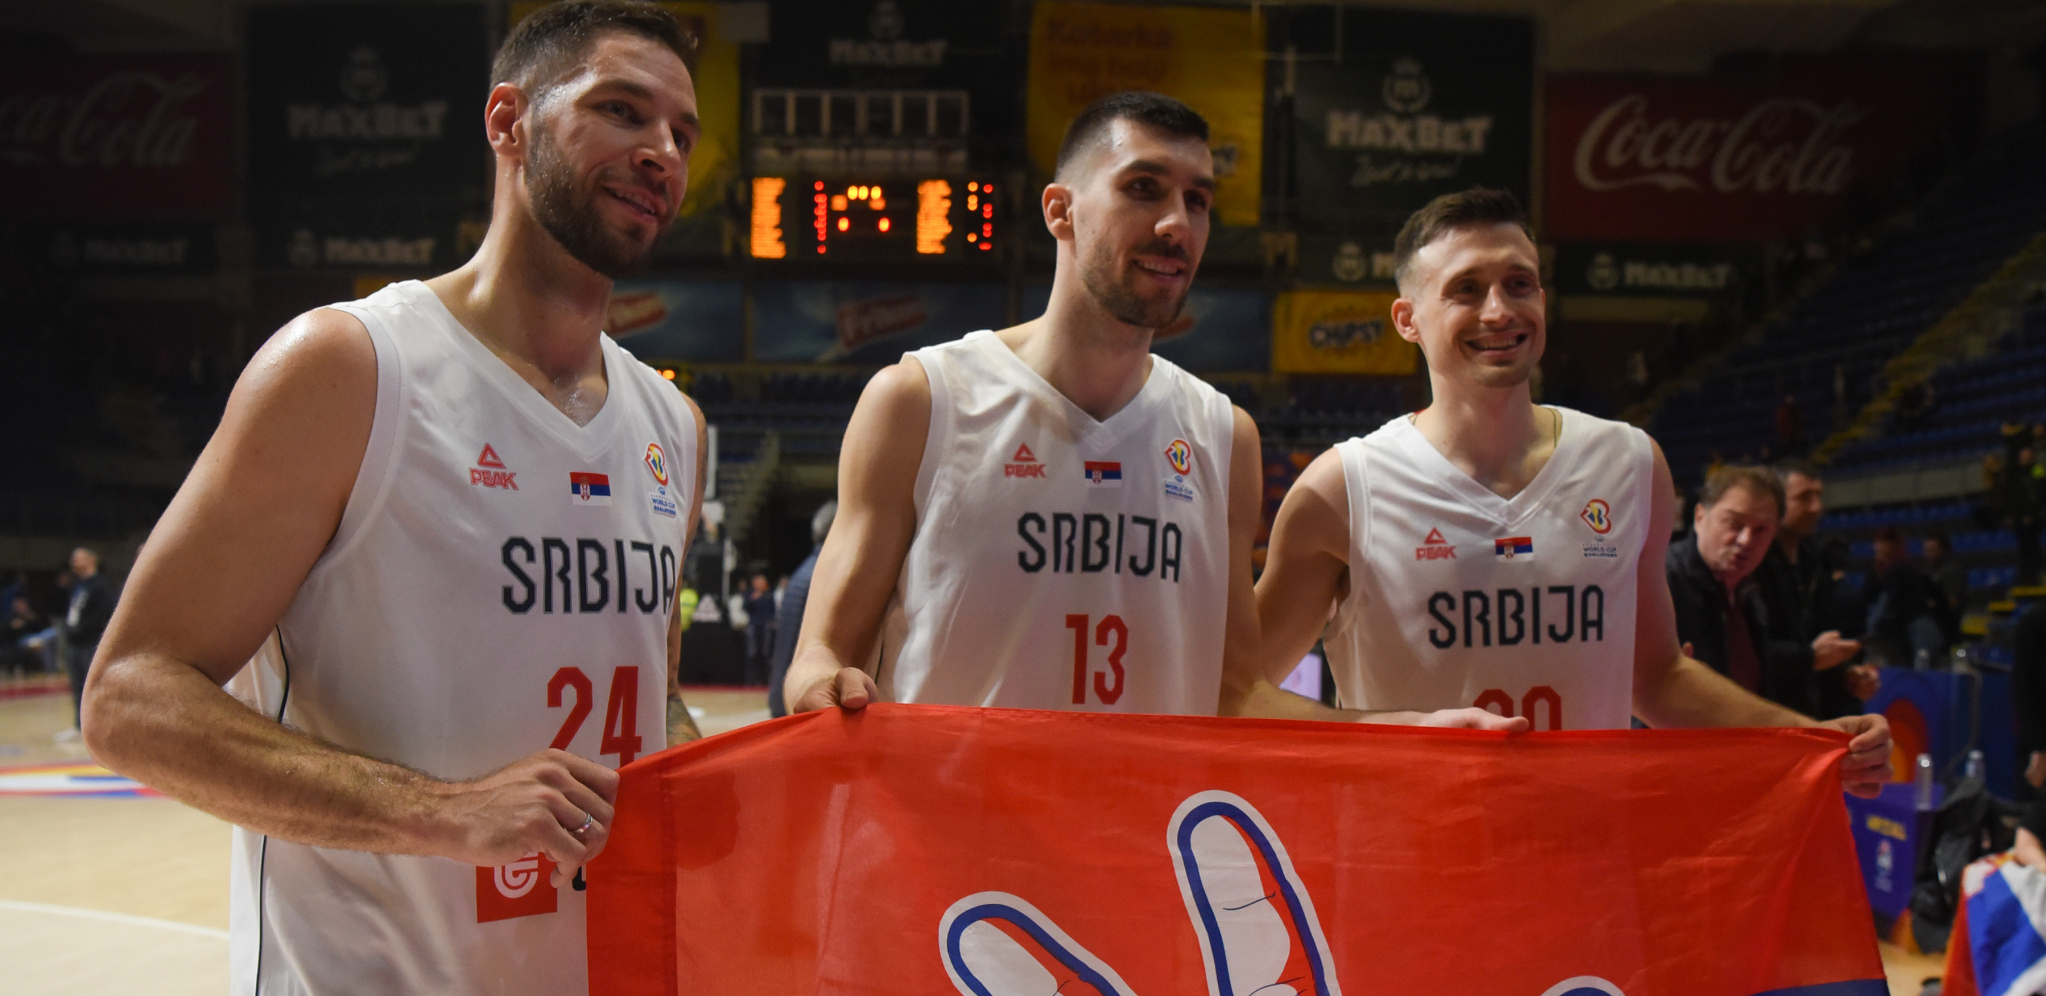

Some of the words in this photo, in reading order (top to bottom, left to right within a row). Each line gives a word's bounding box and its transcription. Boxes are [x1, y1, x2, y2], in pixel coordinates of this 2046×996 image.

[1327, 110, 1493, 153] MAXBET
[1573, 94, 1868, 192] Coca-Cola
[469, 468, 519, 490] PEAK
[1004, 464, 1046, 478] PEAK
[501, 536, 677, 616] SRBIJA
[1017, 512, 1182, 583] SRBIJA
[1415, 545, 1457, 560] PEAK
[1428, 585, 1604, 649] SRBIJA
[1065, 614, 1129, 705] 13
[547, 666, 642, 770] 24
